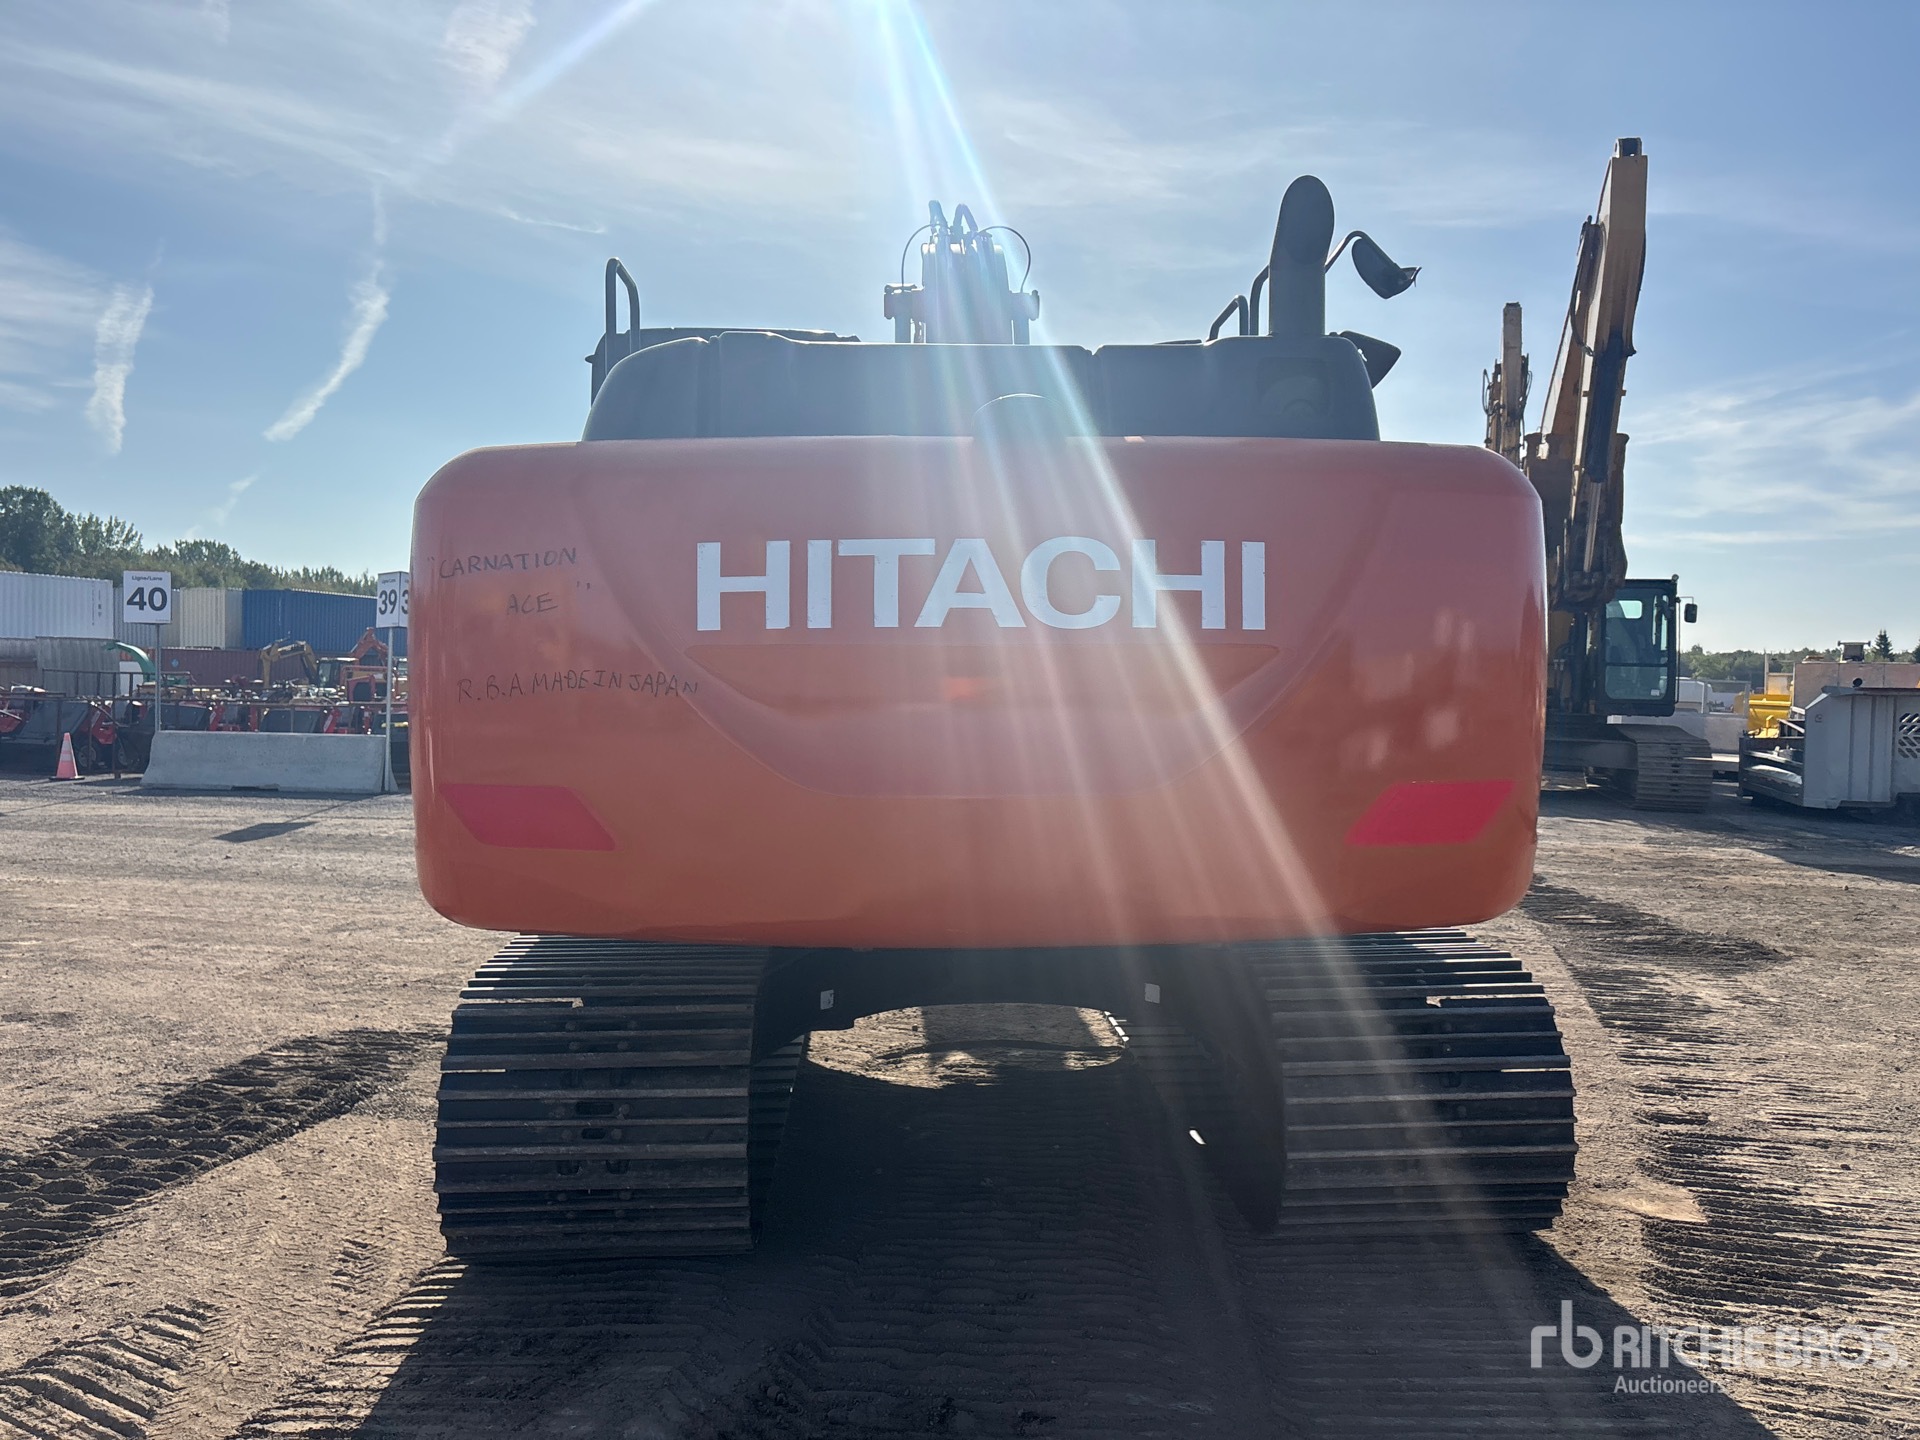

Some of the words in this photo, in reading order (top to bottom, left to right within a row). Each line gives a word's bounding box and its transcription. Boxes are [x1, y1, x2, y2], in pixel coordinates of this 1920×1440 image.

[697, 536, 1266, 631] HITACHI
[126, 586, 168, 612] 40
[378, 588, 398, 615] 39
[401, 589, 409, 615] 3
[628, 671, 699, 698] JAPAN
